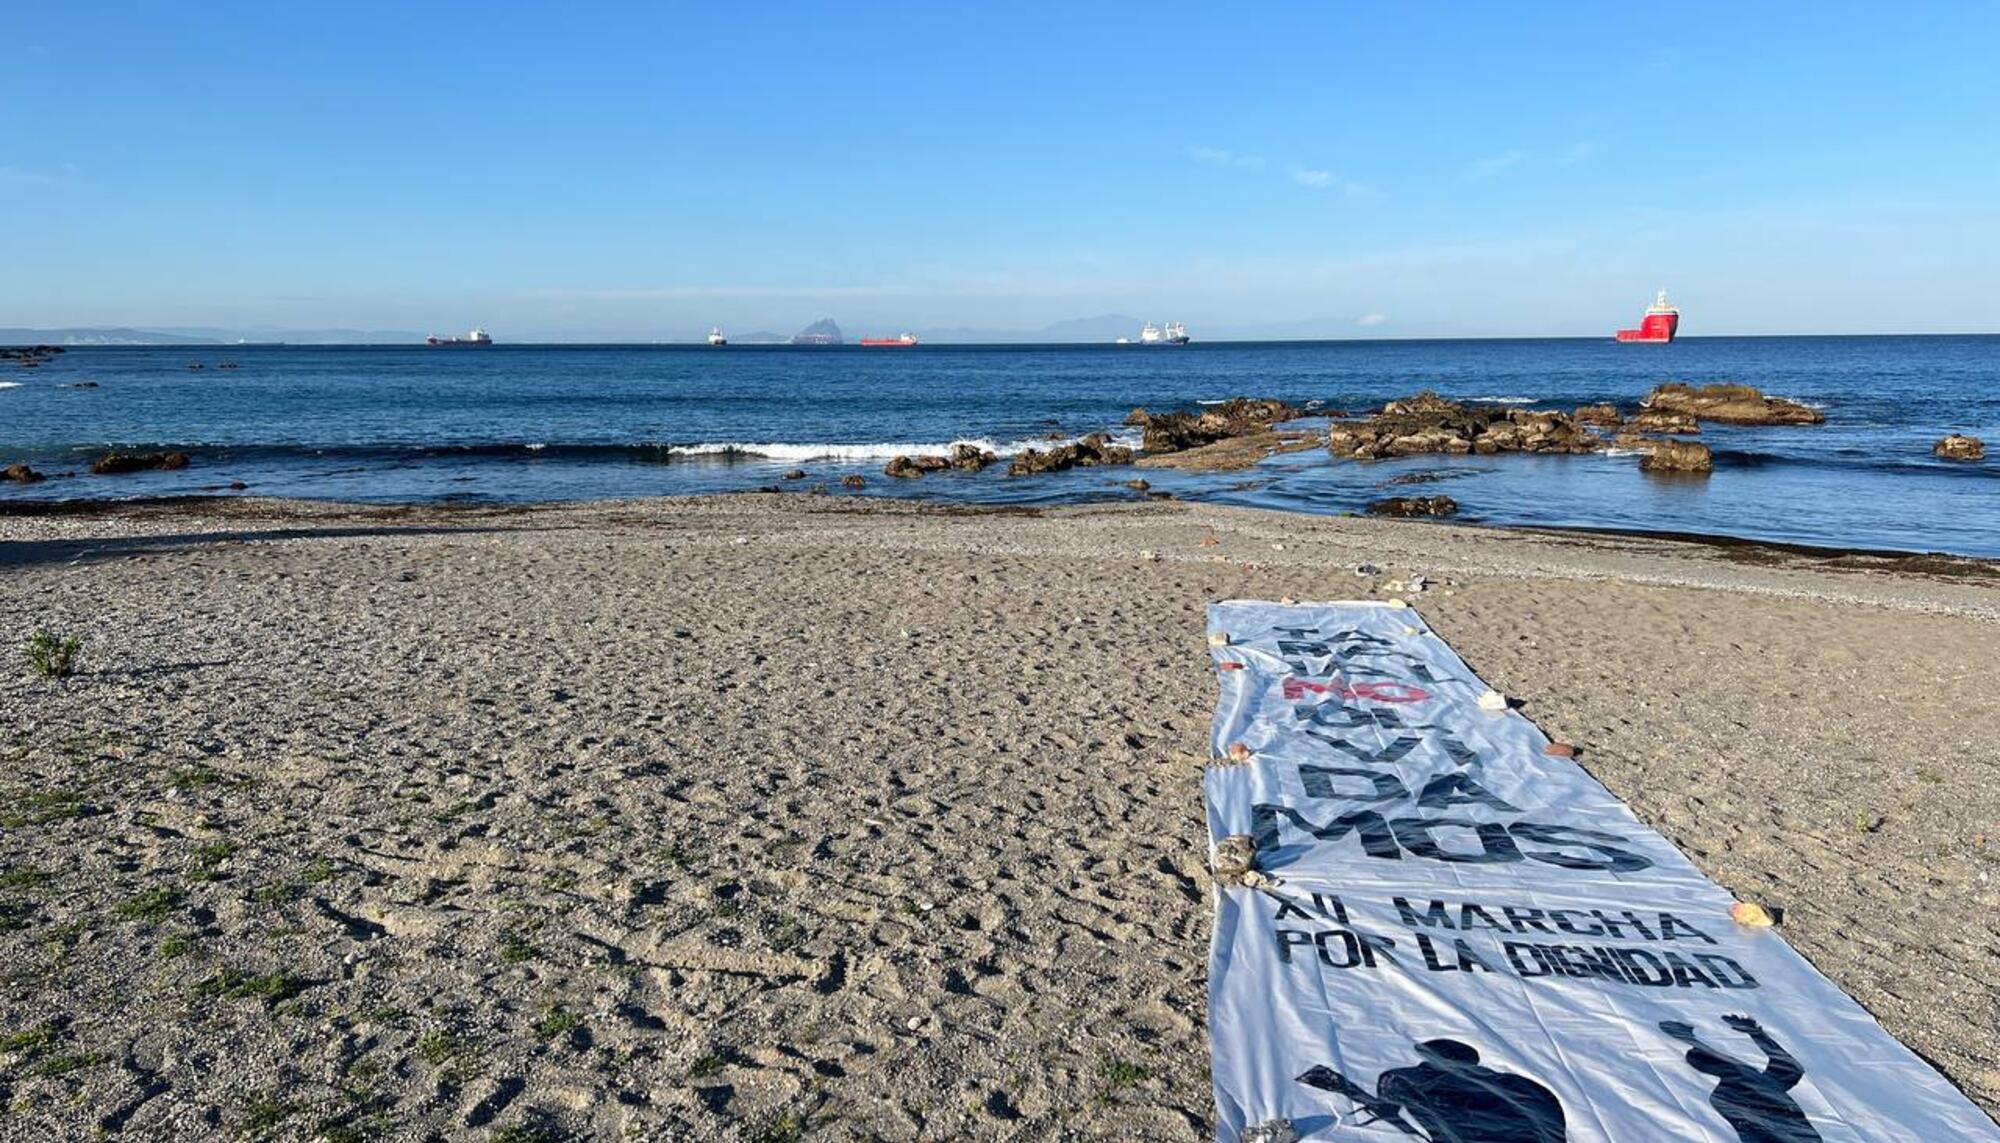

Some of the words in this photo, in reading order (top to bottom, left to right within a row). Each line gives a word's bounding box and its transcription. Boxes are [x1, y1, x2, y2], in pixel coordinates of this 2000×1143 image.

[1282, 676, 1433, 702] NO
[1298, 764, 1524, 813] DA
[1251, 803, 1656, 872] MOS
[1275, 893, 1351, 925] XII
[1393, 896, 1719, 945] MARCHA
[1275, 929, 1396, 969] POR
[1415, 933, 1488, 973] LA
[1503, 941, 1762, 990] DIGNIDAD
